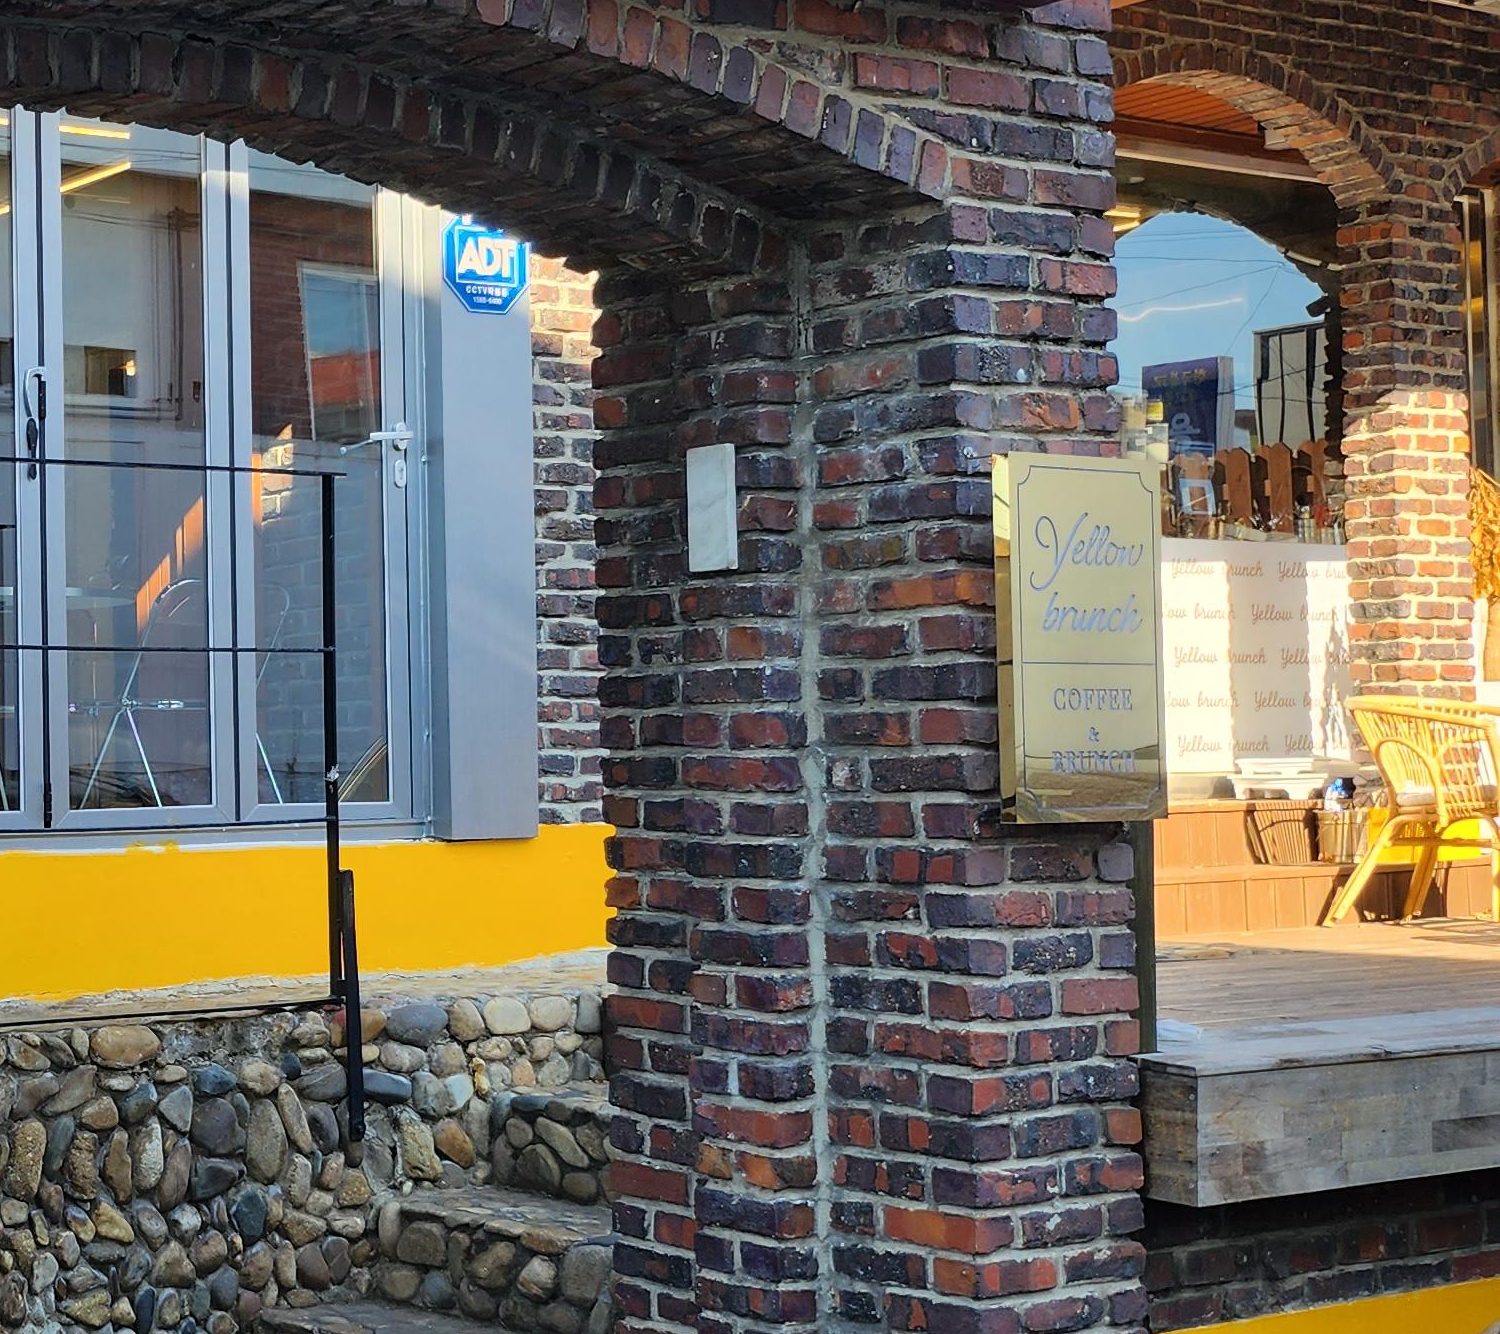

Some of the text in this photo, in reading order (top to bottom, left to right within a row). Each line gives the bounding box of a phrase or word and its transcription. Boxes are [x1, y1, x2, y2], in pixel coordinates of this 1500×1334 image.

[458, 236, 517, 278] ADT
[1029, 512, 1144, 591] Yellow
[1043, 591, 1144, 634] brunch
[1251, 603, 1294, 625] Yellow
[1053, 687, 1133, 711] COFFEE
[1254, 690, 1297, 712] Yellow
[1088, 726, 1100, 743] &
[1051, 749, 1136, 774] BRUNCH
